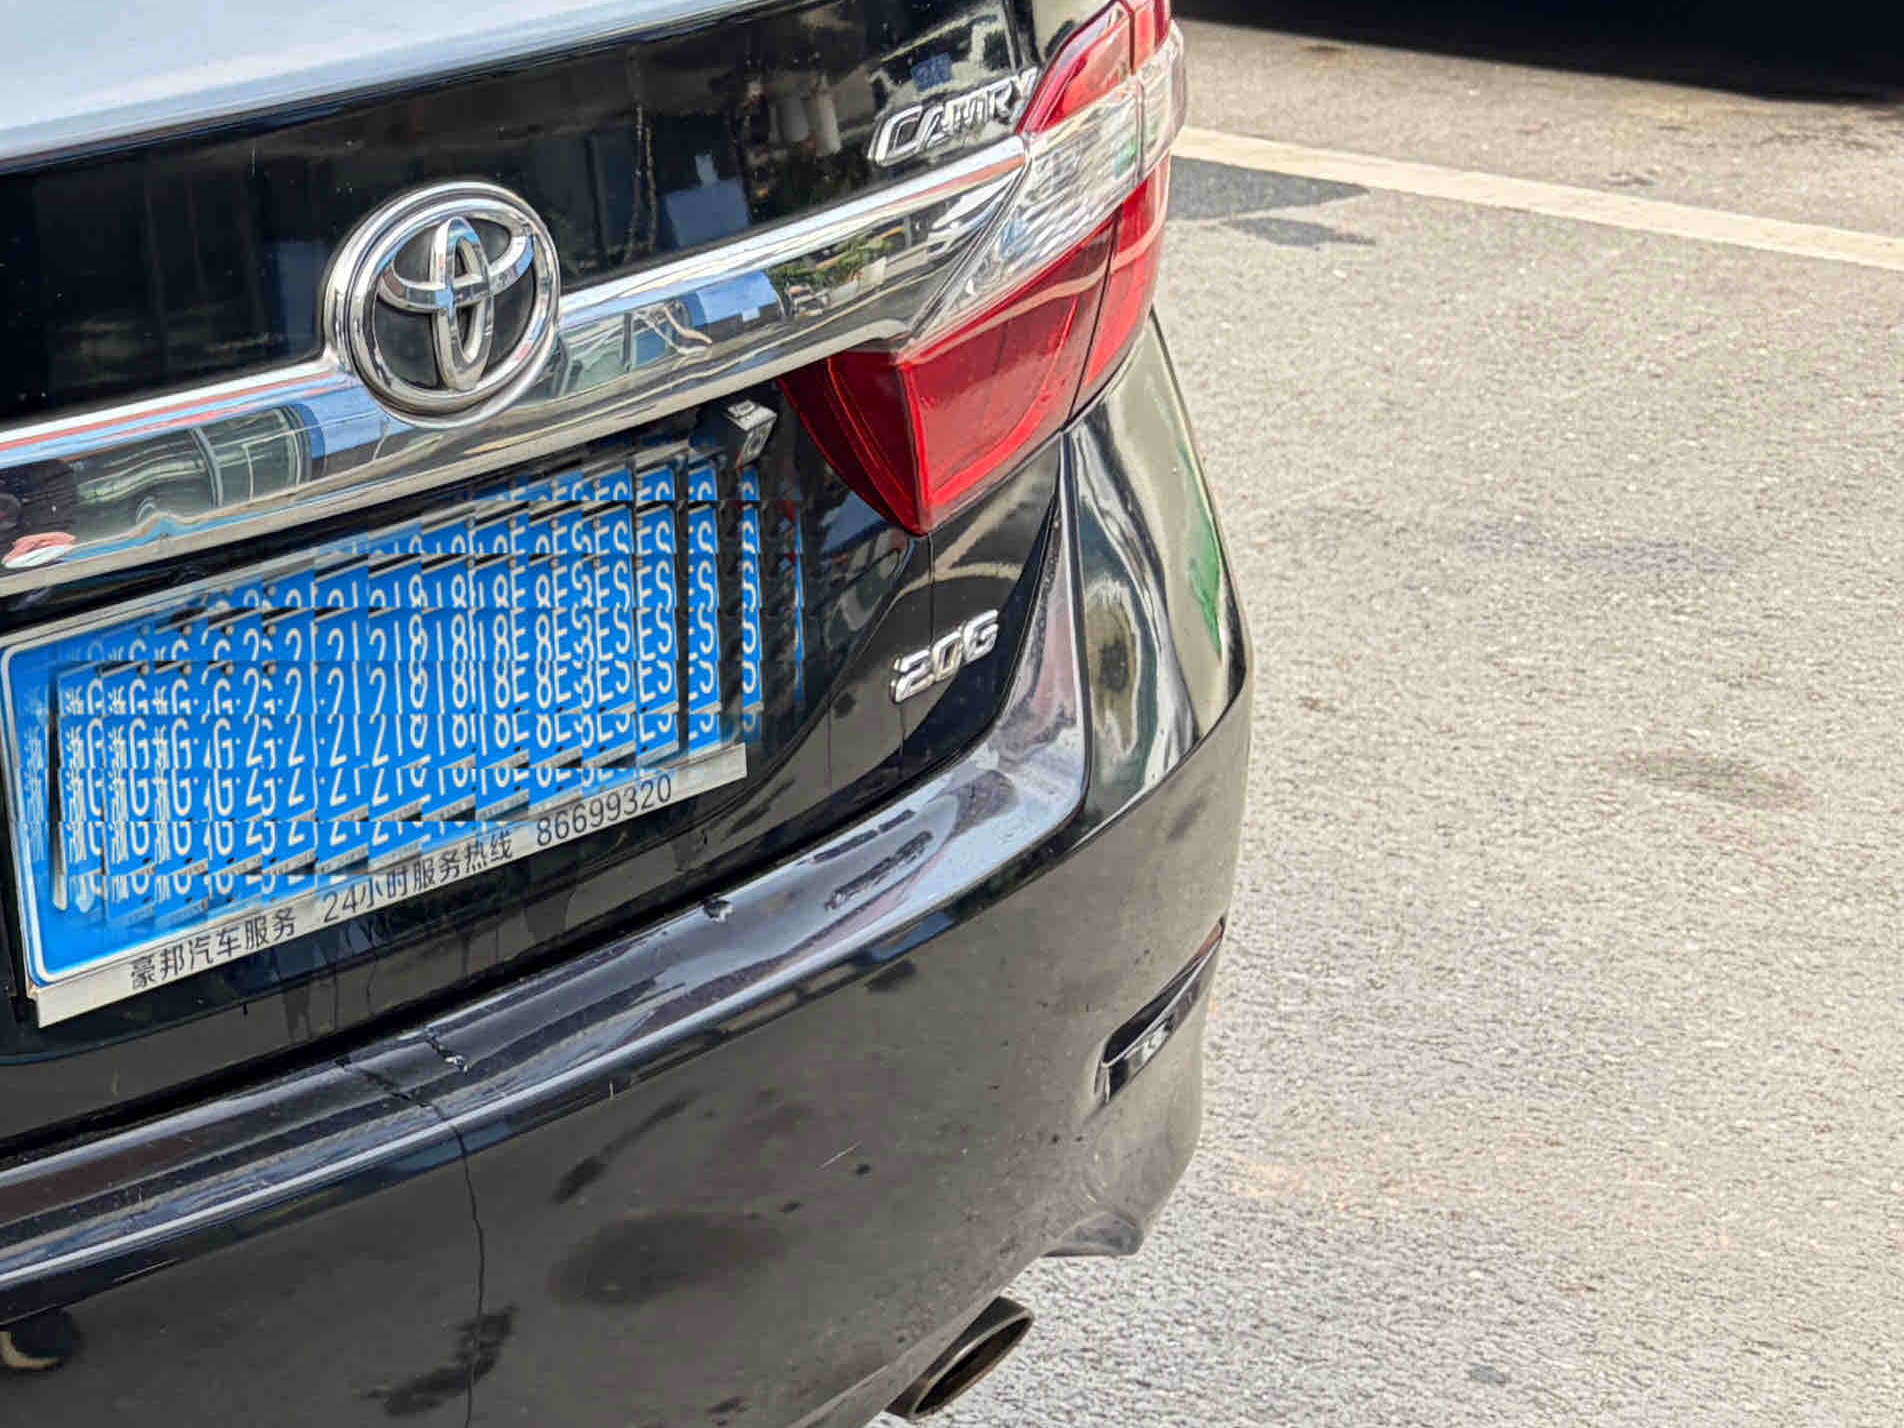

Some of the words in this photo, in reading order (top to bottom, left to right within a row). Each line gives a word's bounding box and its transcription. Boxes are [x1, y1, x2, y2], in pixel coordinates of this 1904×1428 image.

[130, 909, 298, 991] 豪邦汽车服务
[322, 832, 515, 924] 24小时服务热线
[535, 773, 674, 848] 86699320
